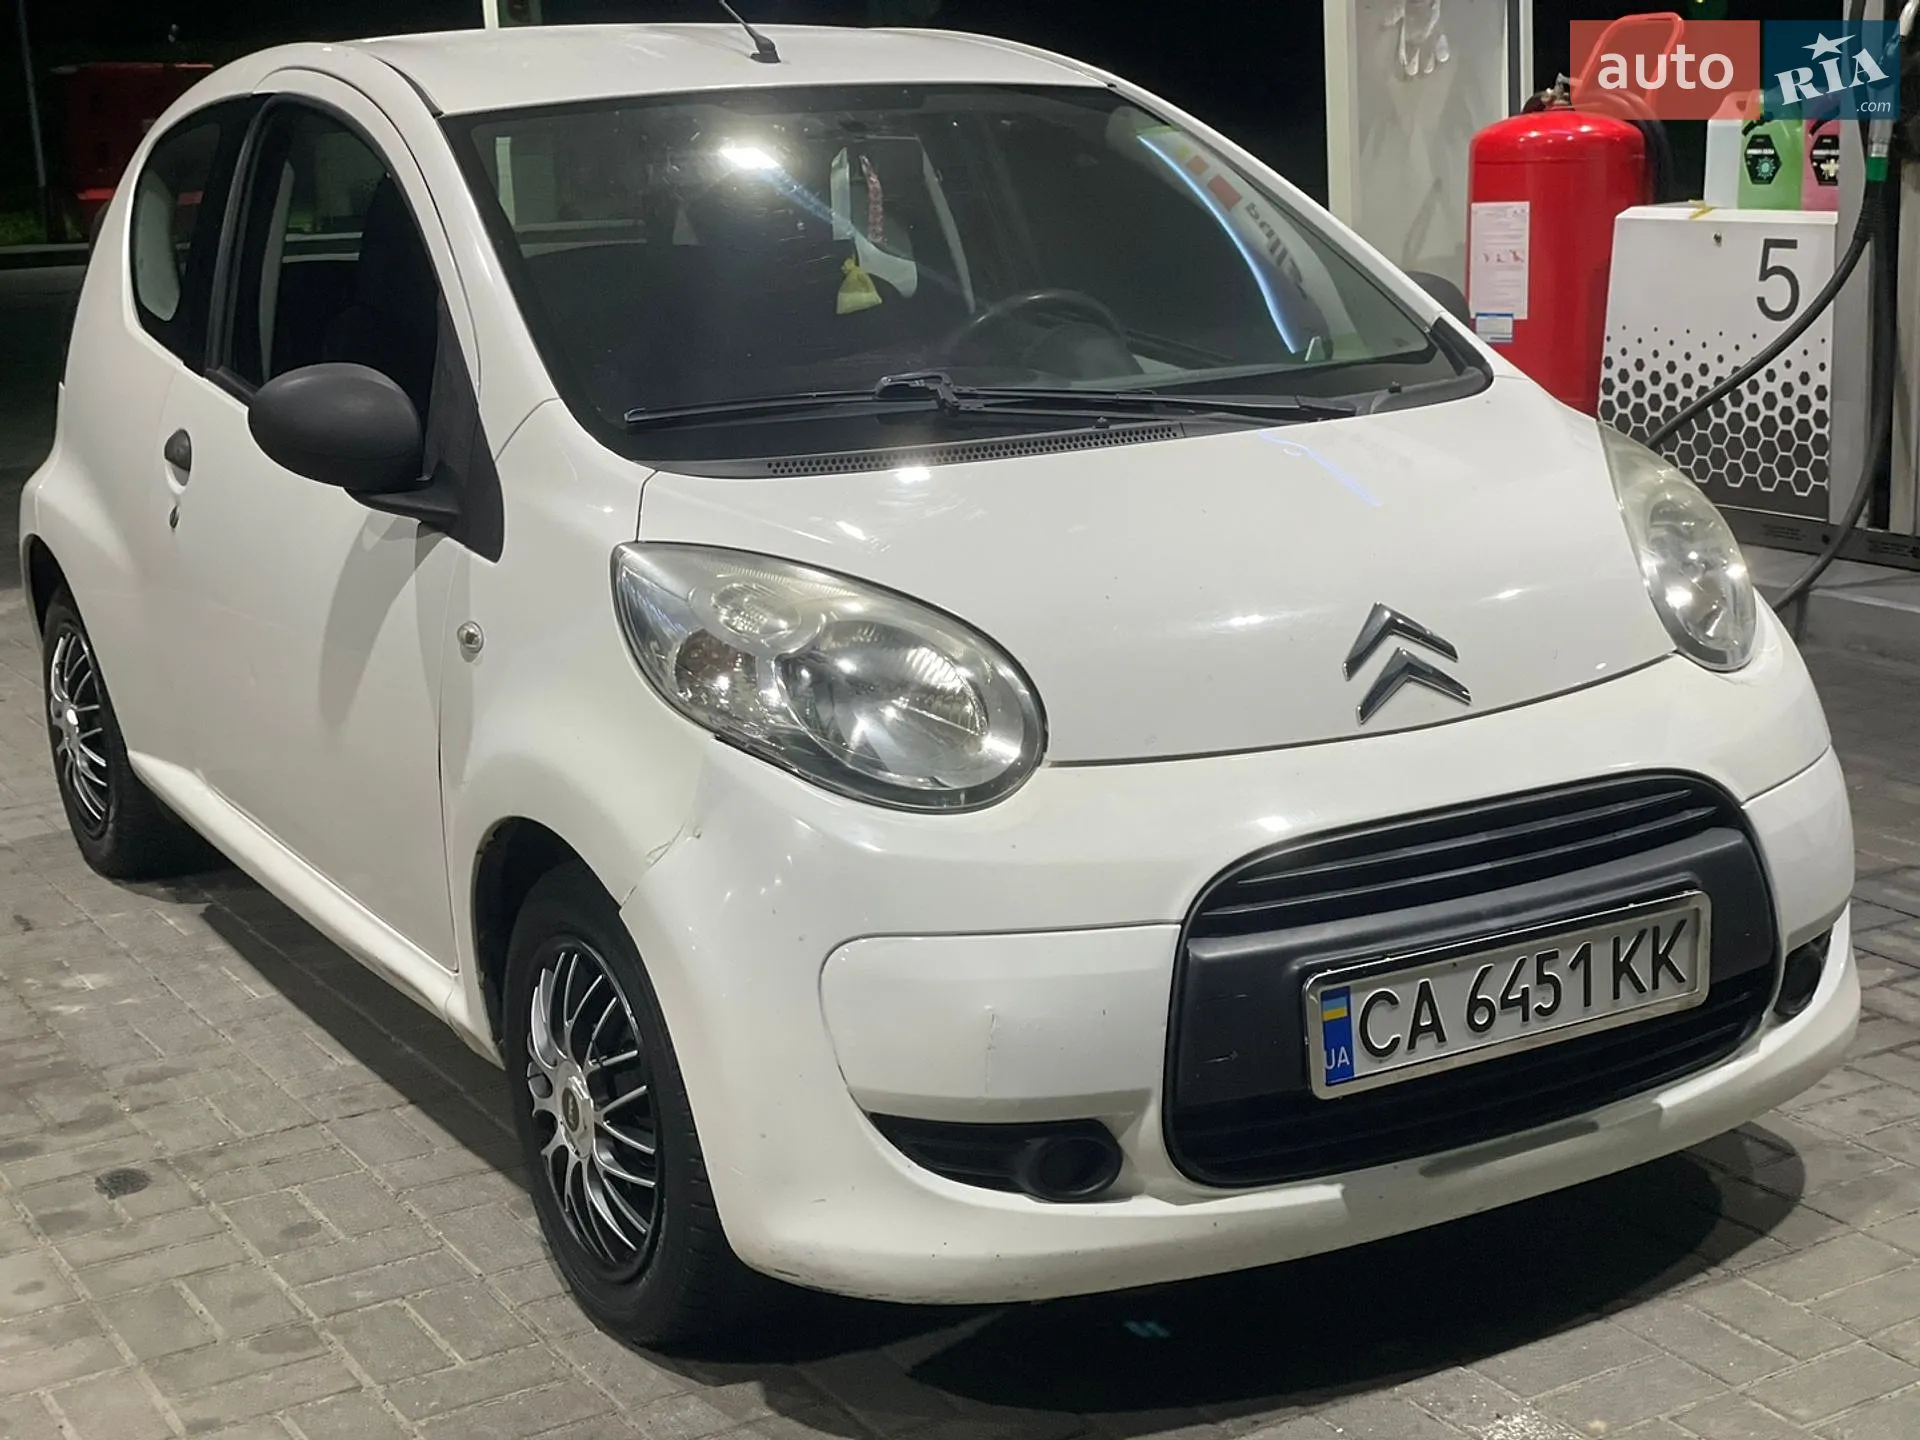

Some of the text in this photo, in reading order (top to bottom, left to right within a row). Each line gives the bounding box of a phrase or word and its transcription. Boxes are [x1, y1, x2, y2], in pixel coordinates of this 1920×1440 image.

[1756, 237, 1800, 322] 5
[1358, 919, 1687, 1058] CA 6451 KK
[1324, 1045, 1350, 1070] UA
